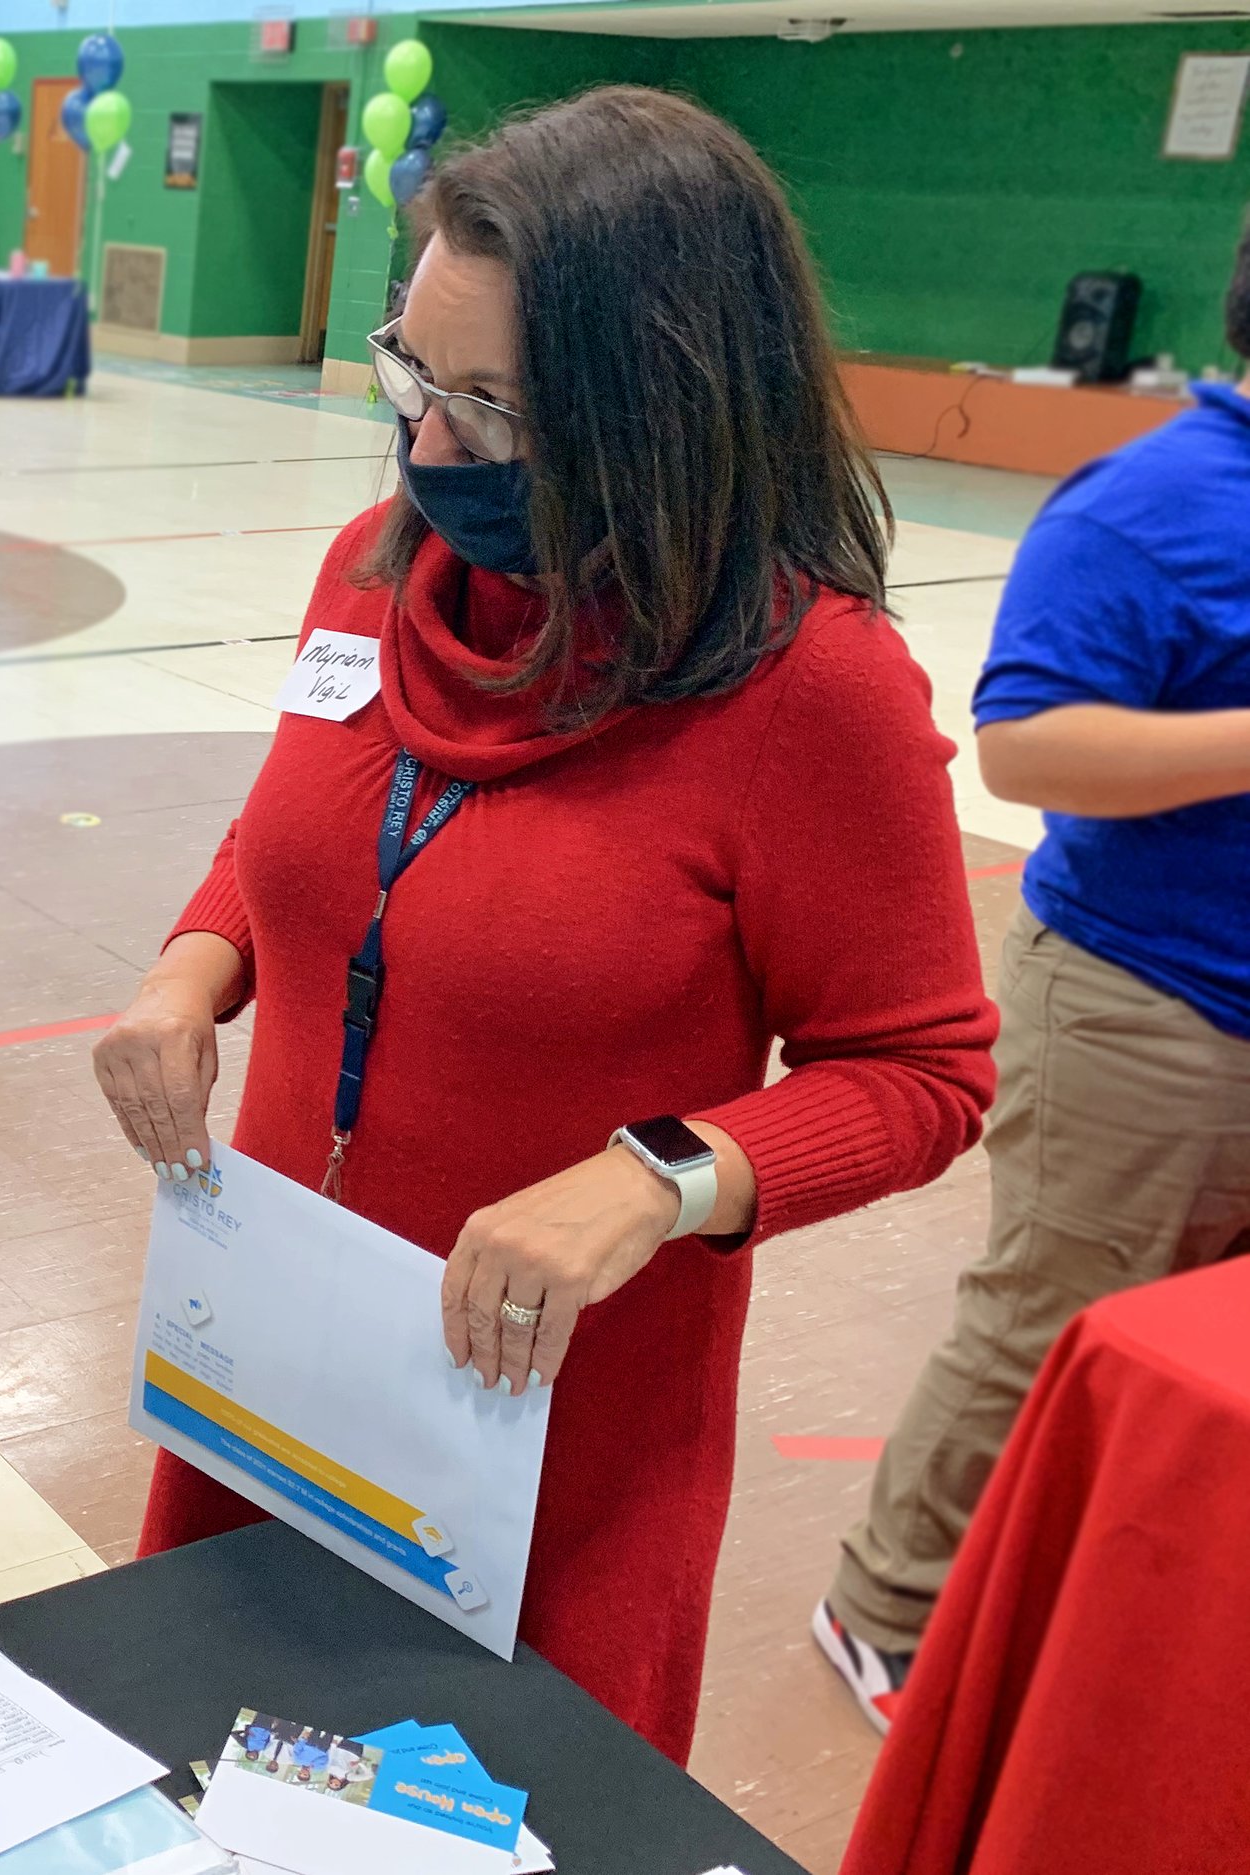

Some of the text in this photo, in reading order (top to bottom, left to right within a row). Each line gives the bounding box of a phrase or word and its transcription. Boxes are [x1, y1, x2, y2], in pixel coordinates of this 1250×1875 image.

[396, 758, 417, 807] CRISTO
[422, 783, 460, 827] CRISTO
[388, 810, 405, 837] REY
[172, 1183, 215, 1217] CRISTO
[217, 1211, 243, 1233] REY
[166, 1320, 193, 1342] SPECIAL
[200, 1341, 233, 1366] MESSAGE
[396, 1782, 454, 1811] House
